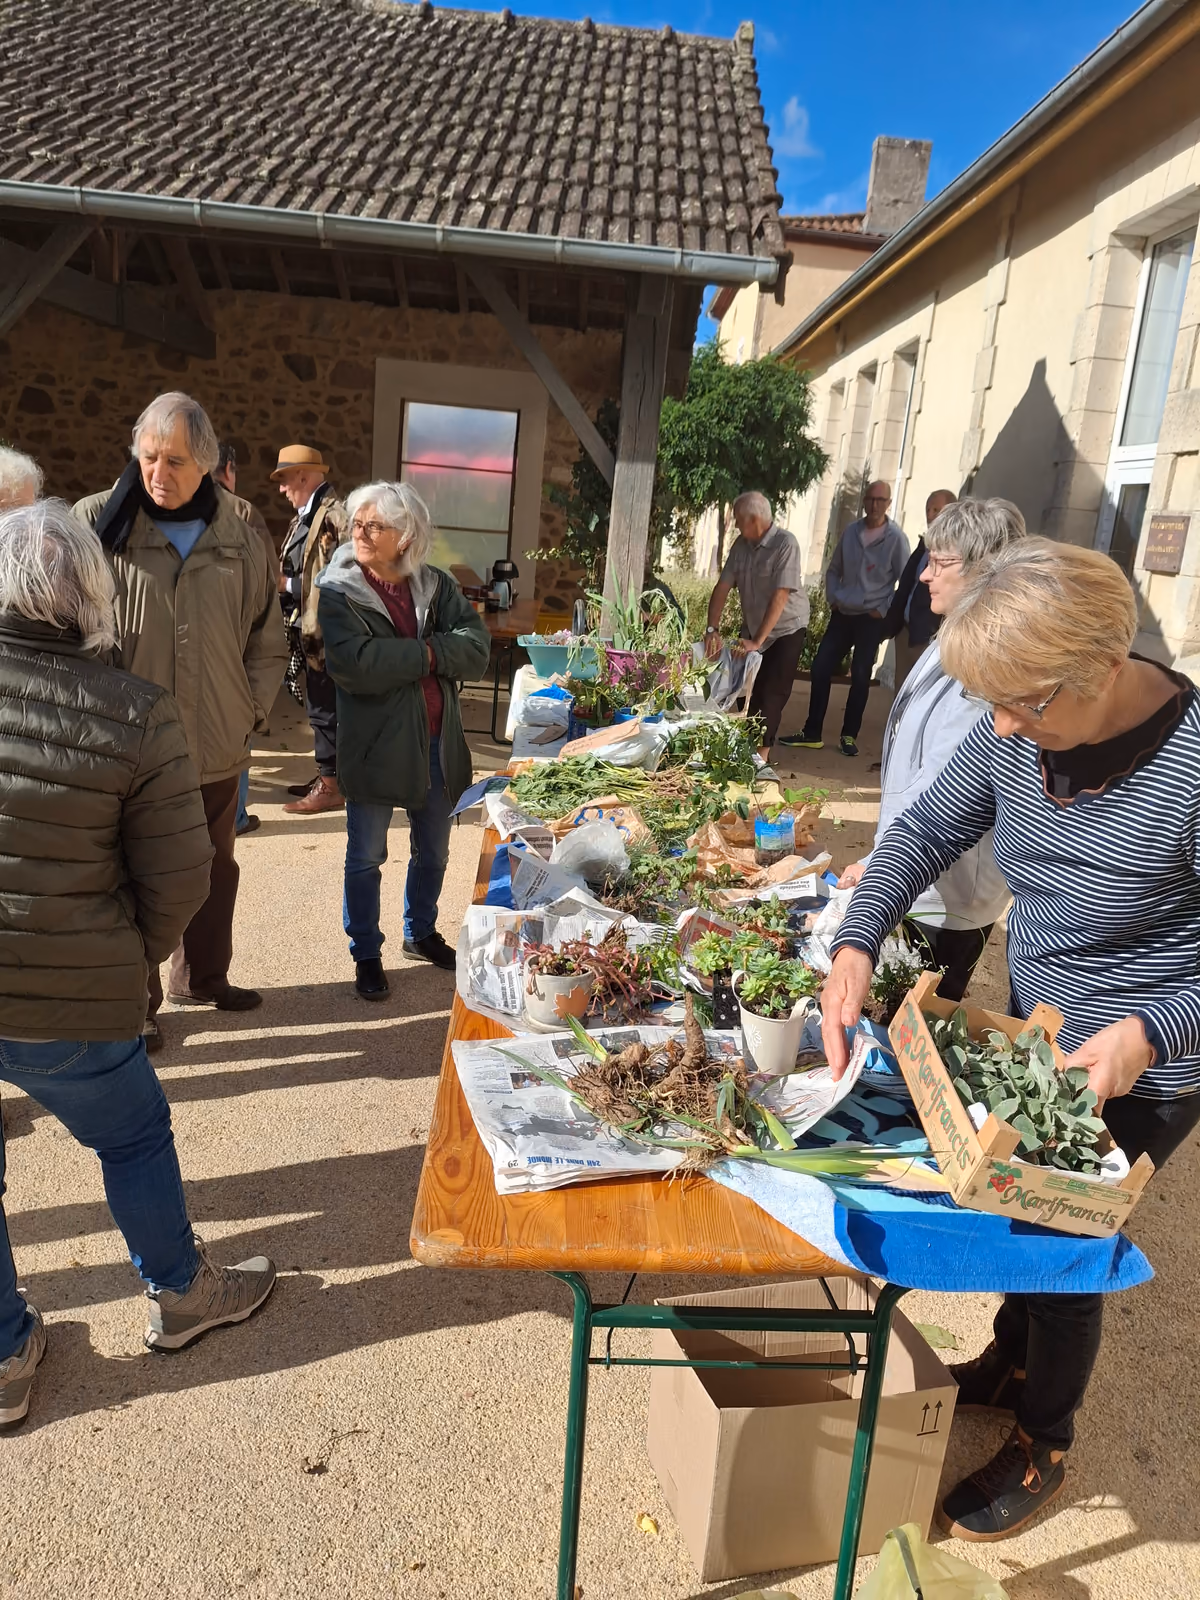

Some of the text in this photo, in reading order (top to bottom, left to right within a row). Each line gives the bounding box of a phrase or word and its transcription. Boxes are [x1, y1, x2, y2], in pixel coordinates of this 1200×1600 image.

[911, 1035, 972, 1171] Marifrancis
[507, 1159, 519, 1168] 29
[526, 1156, 552, 1165] MONDE
[554, 1156, 563, 1164] LE
[999, 1184, 1119, 1227] Marifrancis
